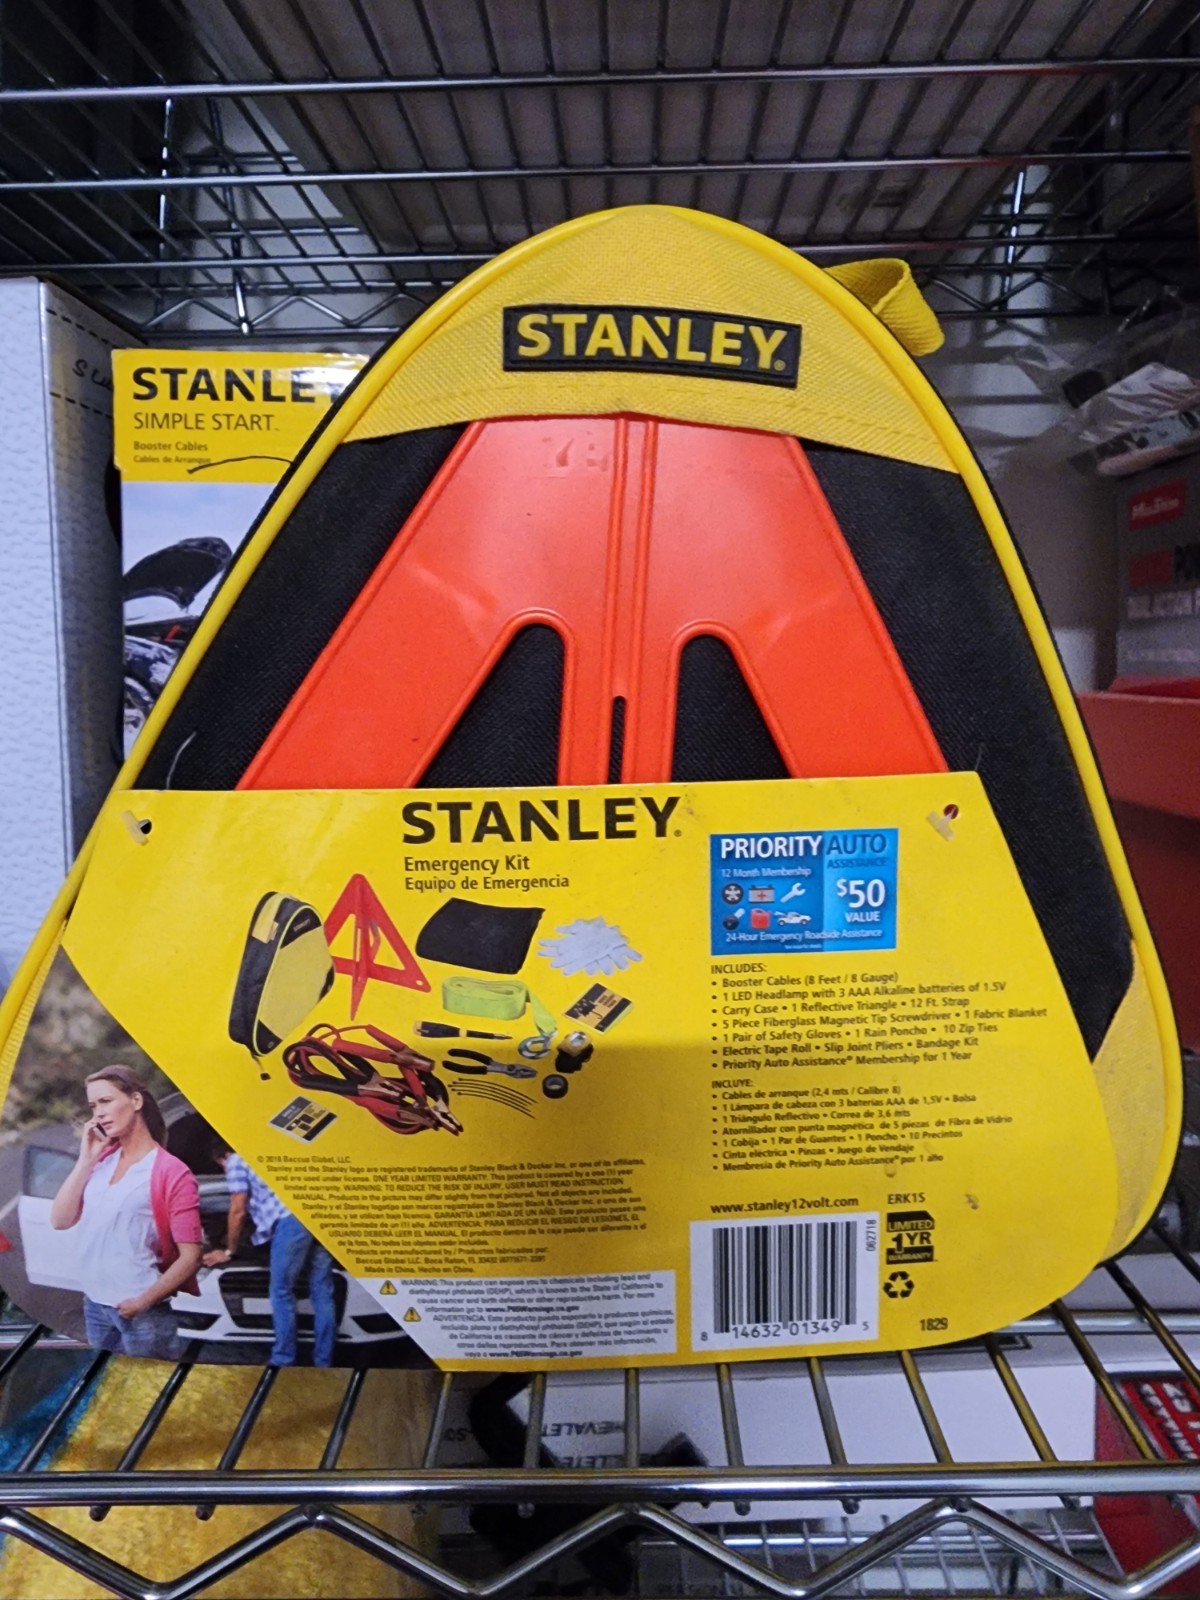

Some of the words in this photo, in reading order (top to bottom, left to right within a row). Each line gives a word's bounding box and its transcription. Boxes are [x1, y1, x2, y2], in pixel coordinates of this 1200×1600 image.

[132, 367, 340, 404] STANLE
[134, 412, 205, 430] SIMPLE
[134, 441, 172, 451] Booster
[176, 442, 208, 451] Cables
[174, 456, 211, 464] Arranque
[721, 835, 822, 859] PRIORITY
[826, 833, 886, 855] AUTO
[404, 857, 498, 874] Emergency
[505, 855, 530, 870] Kit
[721, 869, 731, 877] 12
[733, 868, 760, 877] Month
[762, 866, 811, 877] Membership
[827, 858, 887, 869] ASSISTANCE
[405, 877, 456, 893] Equipo
[462, 876, 478, 890] de
[483, 875, 569, 892] Emergencia
[837, 879, 885, 908] $50
[845, 911, 880, 922] VALUE
[726, 932, 758, 942] 24-Hour
[760, 931, 803, 942] Emergency
[805, 930, 840, 940] Roadside
[841, 929, 882, 937] Assistance
[711, 963, 767, 974] INCLUDES:
[722, 977, 763, 988] Booster
[767, 976, 802, 986] Cables
[805, 975, 815, 987] (8
[819, 975, 841, 984] Feet
[851, 973, 857, 983] 8
[861, 972, 898, 984] Gauge)
[723, 992, 728, 1001] 1
[732, 991, 752, 1001] LED
[755, 990, 808, 1000] Headlamp
[812, 988, 835, 998] with
[839, 988, 845, 997] 3
[848, 987, 870, 997] AAA
[874, 986, 915, 996] Alkaline
[919, 984, 965, 994] batteries
[969, 982, 979, 992] of
[984, 982, 1006, 991] 1.5V
[722, 1006, 750, 1016] Carry
[754, 1005, 778, 1014] Case
[792, 1004, 797, 1012] 1
[801, 1002, 853, 1011] Reflective
[857, 1001, 897, 1012] Triangle
[910, 998, 922, 1008] 12
[926, 998, 938, 1007] Ft.
[942, 997, 970, 1008] Strap
[723, 1020, 729, 1029] 5
[732, 1019, 760, 1028] Piece
[763, 1017, 816, 1028] Fiberglass
[819, 1015, 868, 1026] Magnetic
[872, 1014, 887, 1025] Tip
[891, 1012, 951, 1022] Screwdriver
[974, 1010, 1004, 1019] Fabric
[1008, 1008, 1047, 1018] Blanket
[723, 1033, 728, 1042] 1
[732, 1033, 751, 1042] Pair
[755, 1032, 766, 1041] of
[770, 1030, 802, 1041] Safety
[806, 1029, 842, 1039] Gloves
[856, 1029, 860, 1038] 1
[864, 1028, 887, 1037] Rain
[890, 1026, 927, 1036] Poncho
[944, 1024, 956, 1034] 10
[959, 1024, 975, 1034] Zip
[978, 1023, 998, 1032] Ties
[722, 1046, 761, 1056] Electric
[764, 1045, 788, 1055] Tape
[791, 1043, 811, 1052] Roll
[825, 1042, 844, 1053] Slip
[847, 1041, 872, 1051] Joint
[876, 1040, 904, 1050] Pliers
[916, 1039, 960, 1050] Bandage
[964, 1037, 979, 1046] Kit
[722, 1059, 761, 1070] Priority
[764, 1058, 789, 1067] Auto
[856, 1054, 920, 1065] Membership
[924, 1052, 937, 1062] for
[943, 1051, 947, 1060] 1
[951, 1050, 972, 1060] Year
[711, 1079, 754, 1088] INCLUYE:
[722, 1091, 752, 1100] Cables
[754, 1090, 766, 1099] de
[768, 1090, 810, 1099] arranque
[832, 1088, 848, 1096] mts
[857, 1086, 889, 1095] Calibre
[892, 1085, 901, 1095] 8)
[723, 1104, 727, 1112] 1
[772, 1101, 783, 1110] de
[786, 1100, 817, 1109] cabeza
[839, 1099, 844, 1107] 3
[886, 1098, 906, 1106] AAA
[908, 1097, 919, 1105] de
[953, 1094, 976, 1103] Bolsa
[723, 1116, 727, 1124] 1
[774, 1112, 820, 1121] Reflectivo
[830, 1111, 860, 1119] Correa
[863, 1110, 874, 1118] de
[894, 1110, 910, 1118] mts
[722, 1126, 777, 1136] Atornillador
[780, 1125, 796, 1133] con
[798, 1124, 824, 1134] punta
[879, 1122, 890, 1130] de
[893, 1121, 899, 1129] 5
[902, 1120, 929, 1131] piezas
[935, 1119, 945, 1127] de
[949, 1118, 971, 1126] Fibra
[973, 1117, 984, 1125] de
[987, 1116, 1013, 1124] Vidrio
[731, 1138, 759, 1149] Cobija
[778, 1136, 792, 1145] Par
[795, 1135, 807, 1144] de
[810, 1134, 846, 1144] Guantes
[858, 1134, 861, 1142] 1
[865, 1132, 898, 1141] Poncho
[923, 1130, 962, 1139] Precintos
[723, 1150, 746, 1160] Cinta
[798, 1147, 826, 1156] Pinzas
[836, 1146, 863, 1156] Juego
[865, 1144, 876, 1153] de
[879, 1144, 914, 1153] Vendaje
[775, 1160, 786, 1169] de
[789, 1158, 822, 1169] Priority
[825, 1157, 846, 1166] Auto
[901, 1155, 916, 1165] por
[920, 1154, 924, 1162] 1
[711, 1197, 859, 1214] www.stanley12volt.com
[888, 1193, 926, 1205] ERK1S
[887, 1219, 934, 1231] LIMITED
[866, 1219, 877, 1251] 062718
[891, 1233, 904, 1253] 1
[907, 1232, 931, 1245] YR
[887, 1252, 931, 1261] WARRANTY
[700, 1332, 708, 1341] 8
[733, 1323, 781, 1339] 14632
[789, 1322, 841, 1335] 01349
[863, 1322, 870, 1331] 5
[919, 1318, 948, 1331] 1829
